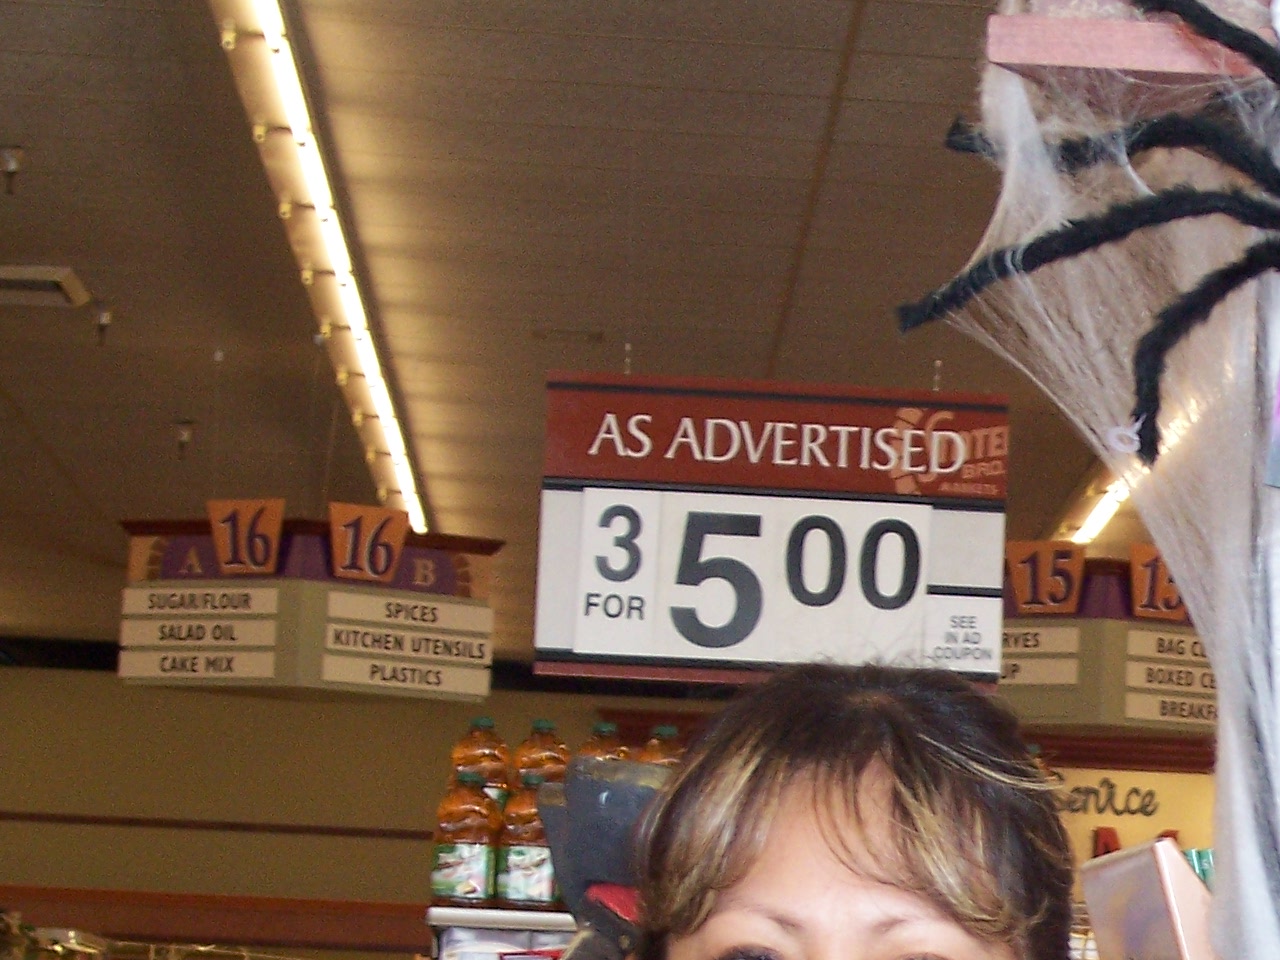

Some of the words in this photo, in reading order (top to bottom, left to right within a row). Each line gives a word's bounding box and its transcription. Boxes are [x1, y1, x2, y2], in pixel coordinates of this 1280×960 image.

[588, 413, 653, 458] AS
[663, 417, 967, 474] ADVERTISED
[219, 505, 271, 567] 16
[341, 515, 395, 578] 16
[595, 503, 642, 582] 3
[179, 546, 202, 573] A
[413, 558, 437, 587] B
[1016, 549, 1075, 606] 15
[385, 602, 439, 623] SPICES
[584, 591, 645, 620] FOR
[159, 624, 206, 642] SALAD
[211, 624, 238, 642] OIL
[950, 615, 978, 630] SEE
[333, 629, 405, 652] KITCHEN
[411, 638, 486, 660] UTENSILS
[1157, 636, 1185, 655] BAG
[160, 655, 199, 673] CAKE
[205, 655, 235, 673] MIX
[370, 664, 442, 686] PLASTICS
[1146, 667, 1194, 687] BOXED
